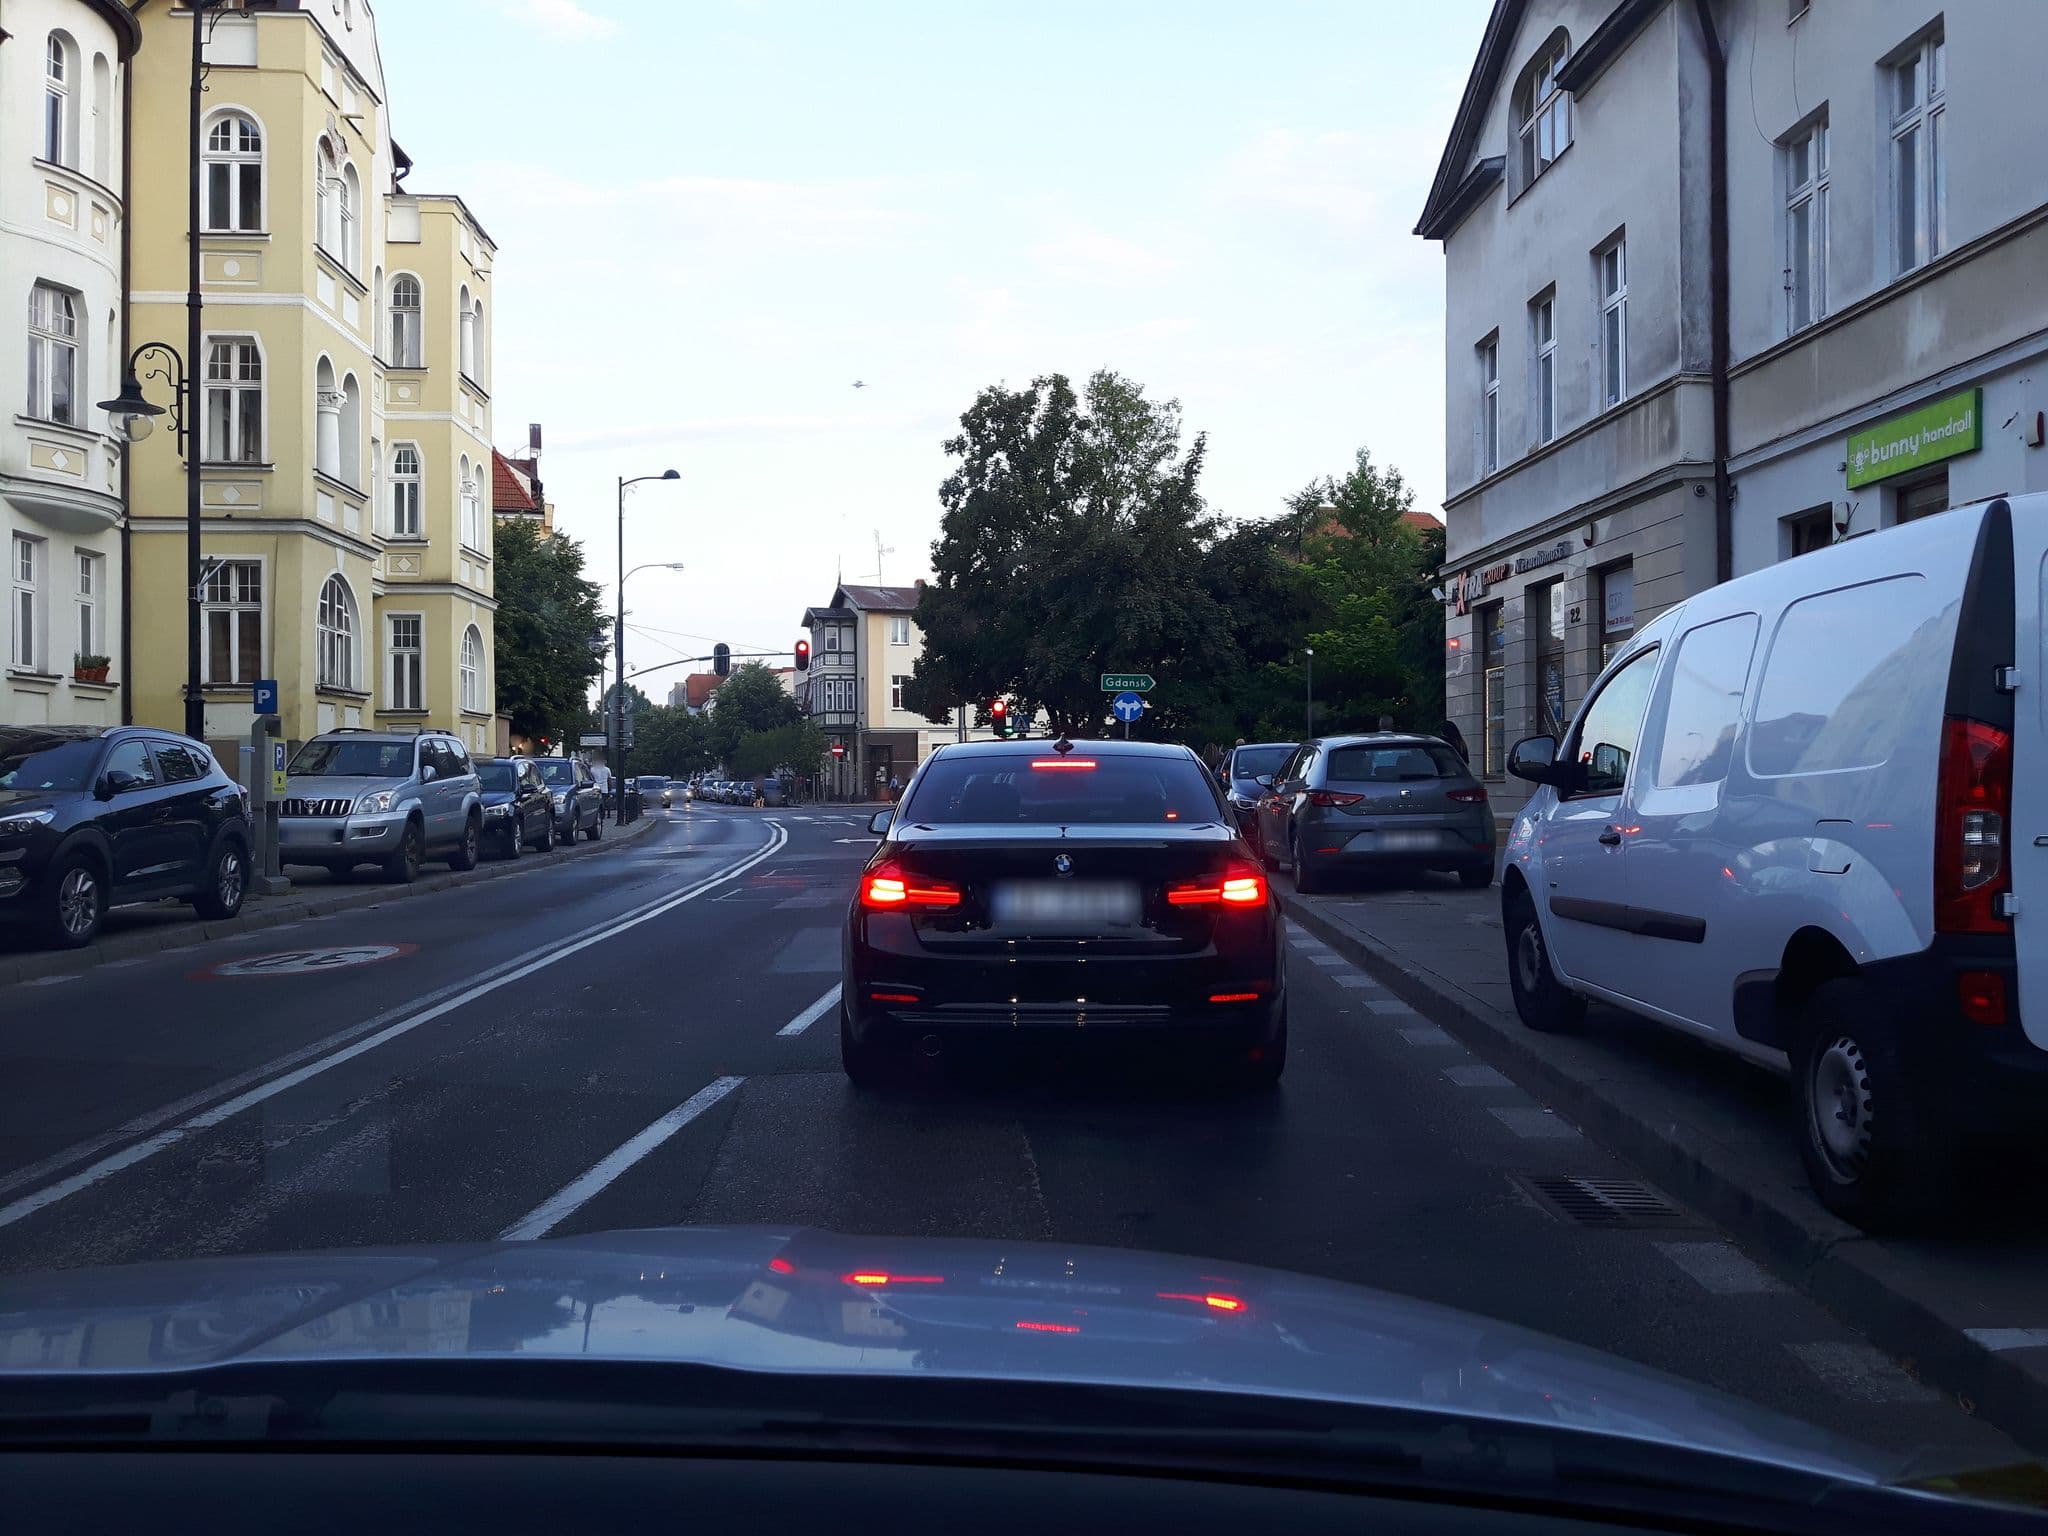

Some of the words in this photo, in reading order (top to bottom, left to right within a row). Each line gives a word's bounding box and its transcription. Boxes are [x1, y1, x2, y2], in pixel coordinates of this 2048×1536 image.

[1871, 433, 1920, 464] bunny
[1922, 409, 1972, 445] handroll
[1482, 563, 1507, 586] GROUP
[1569, 606, 1581, 624] 22
[257, 689, 271, 705] P
